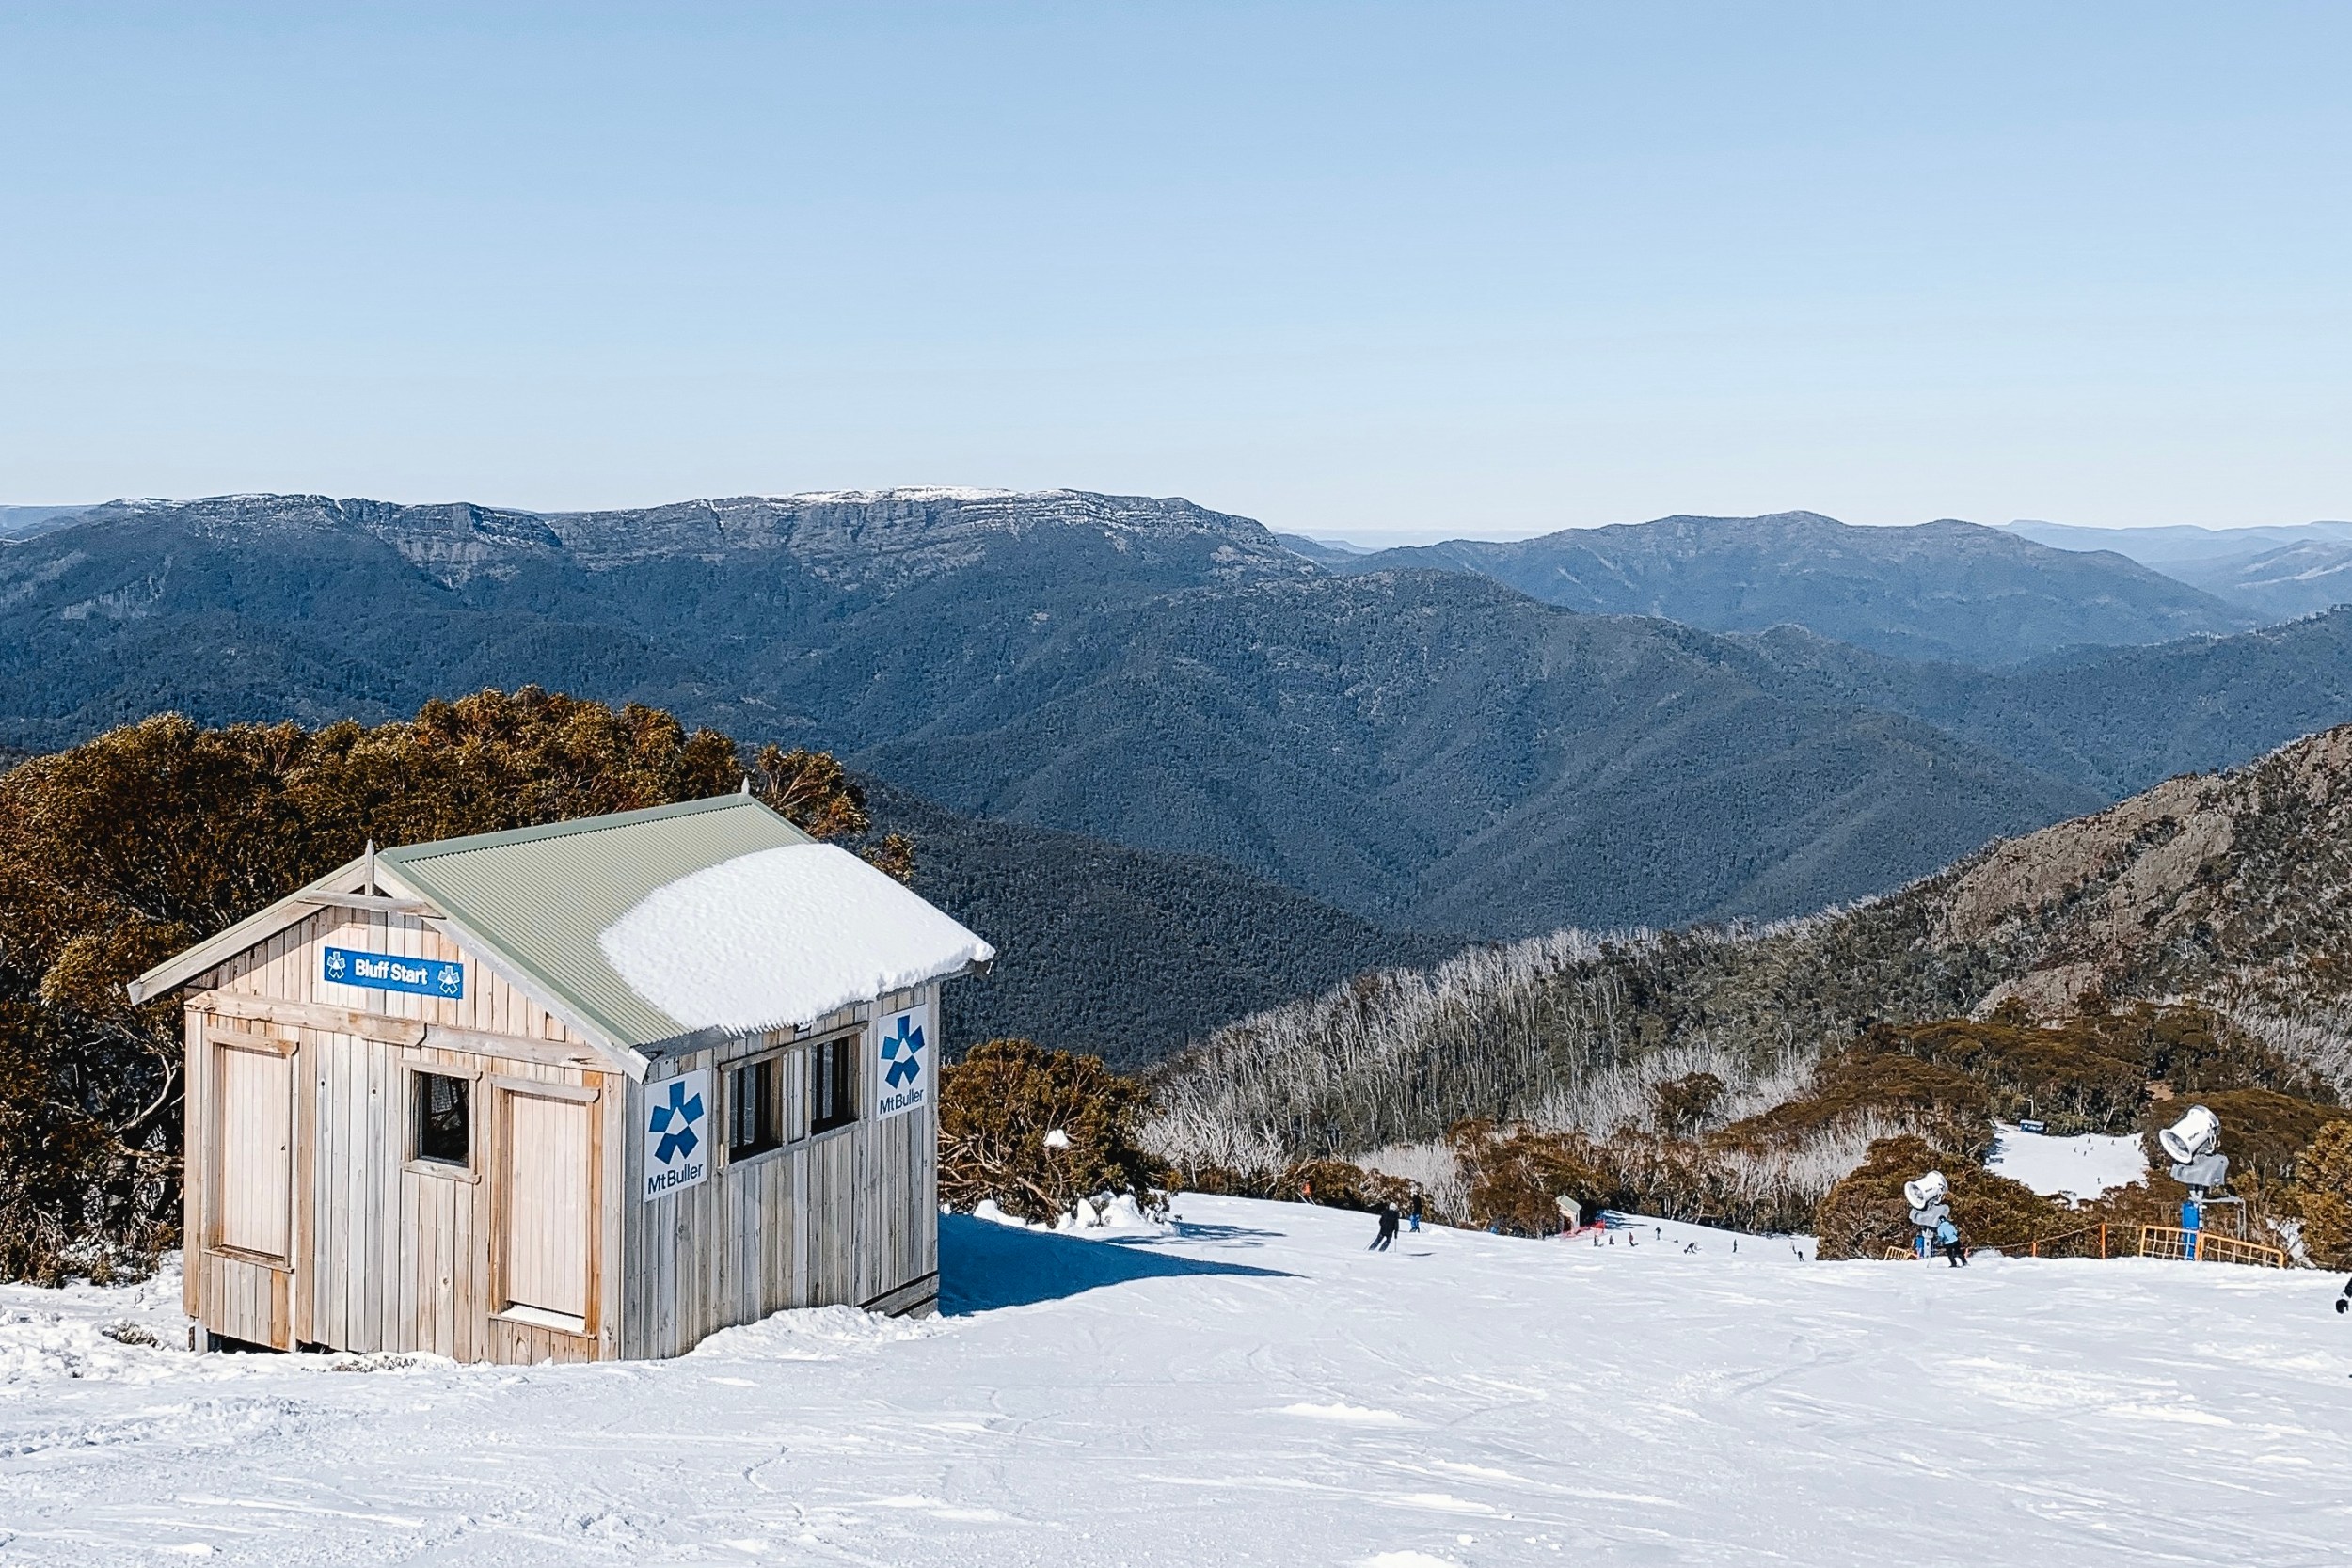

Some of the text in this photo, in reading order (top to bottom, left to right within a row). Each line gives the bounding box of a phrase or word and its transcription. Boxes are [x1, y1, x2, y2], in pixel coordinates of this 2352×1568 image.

[355, 958, 428, 985] Bluff Start
[896, 1088, 924, 1110] Buller
[668, 1163, 704, 1187] Buller
